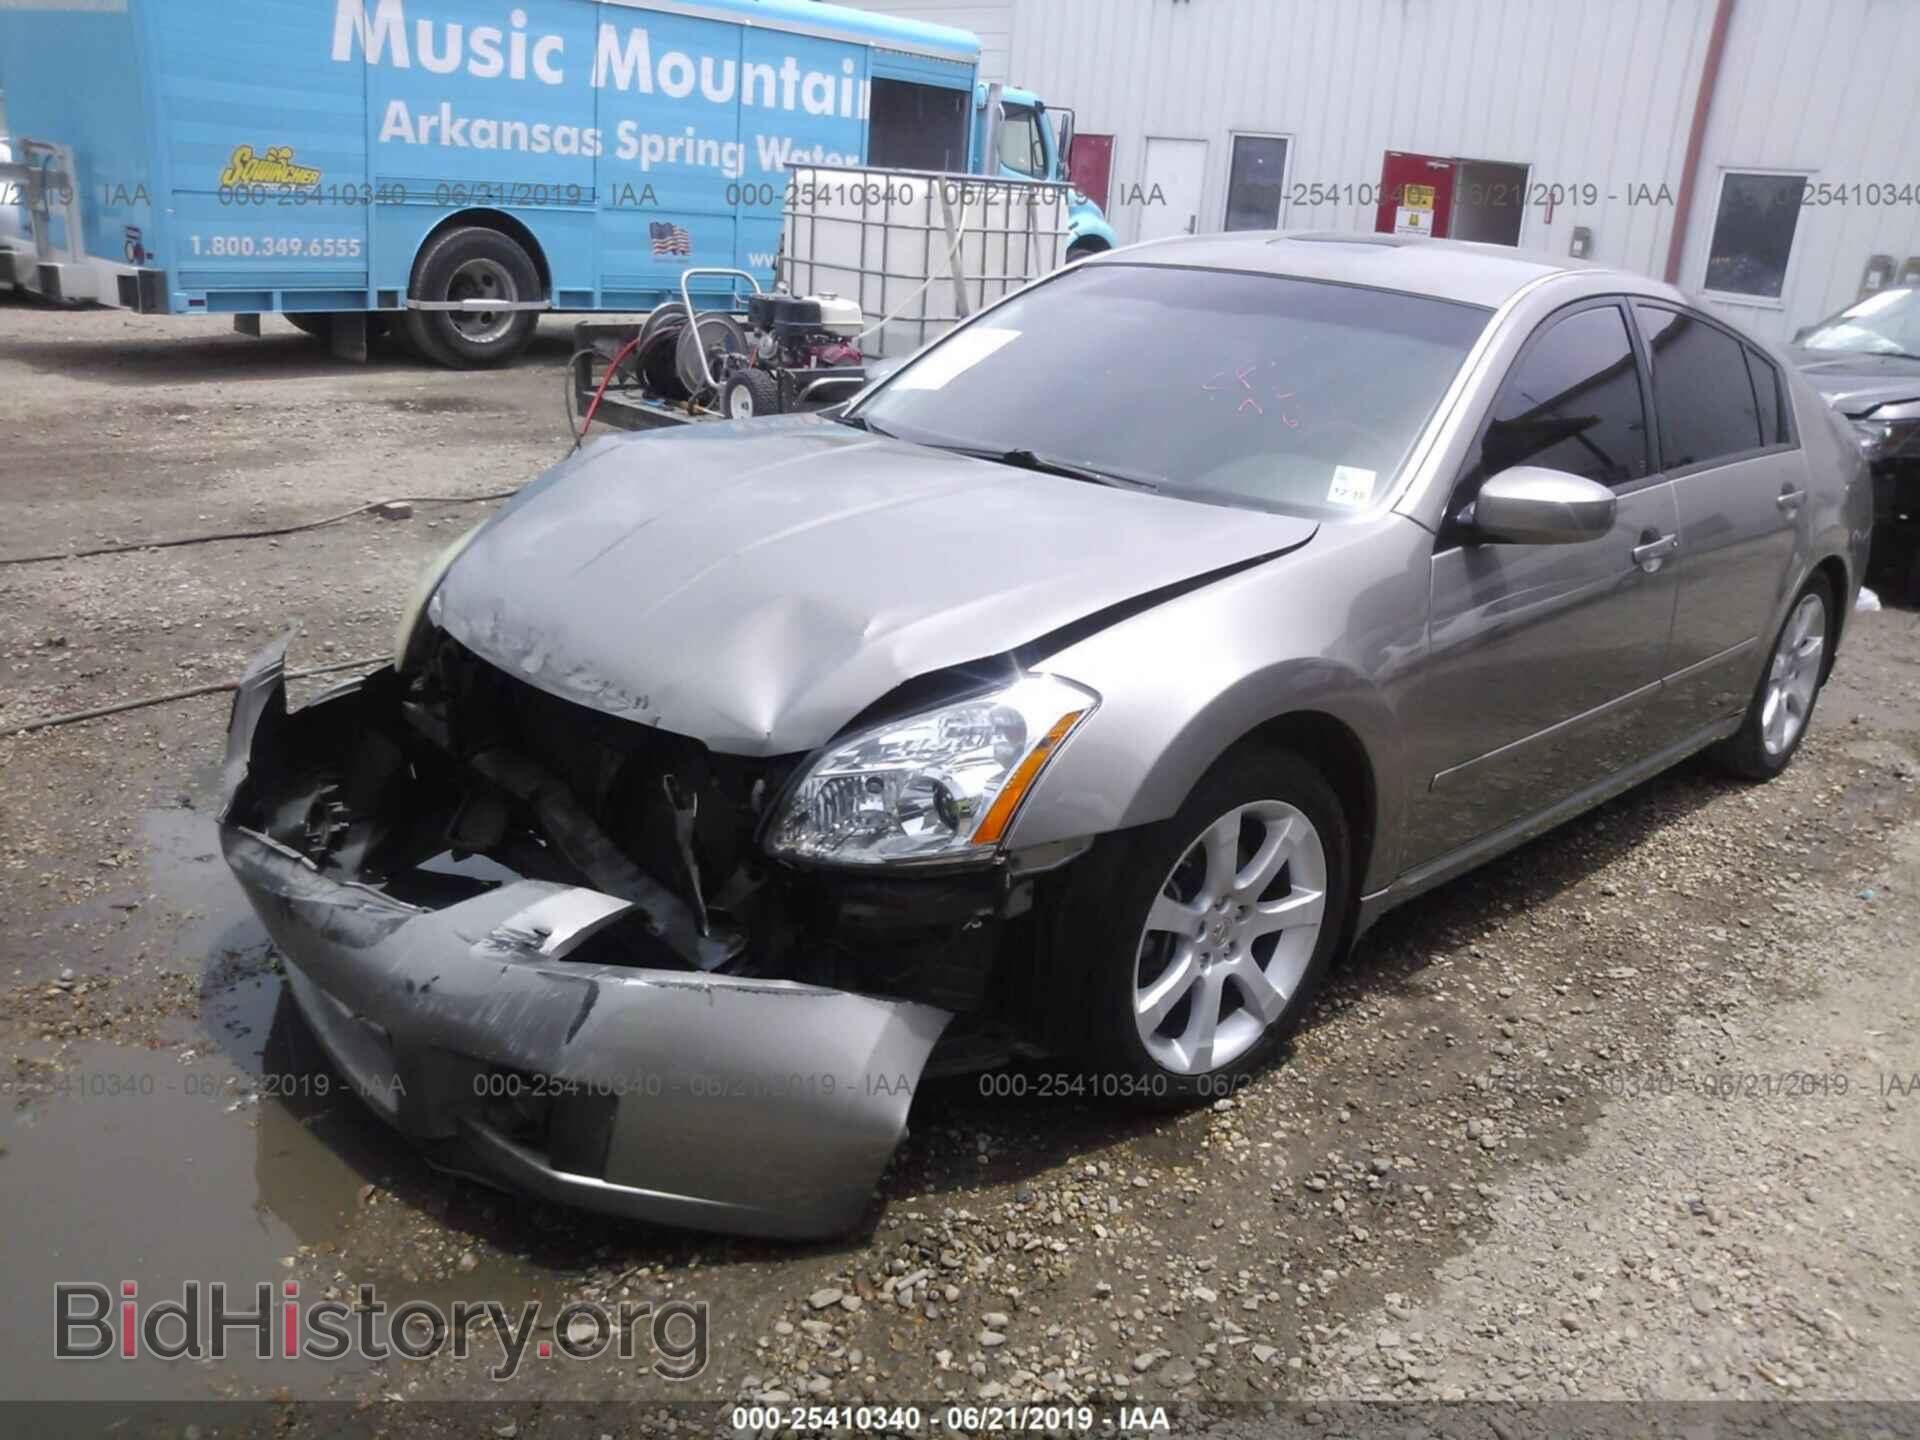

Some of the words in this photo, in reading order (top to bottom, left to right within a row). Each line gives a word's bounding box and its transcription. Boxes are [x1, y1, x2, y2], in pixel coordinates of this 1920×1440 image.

[331, 0, 564, 84] Music
[379, 99, 603, 157] Arkansas
[616, 120, 745, 178] Spring
[191, 235, 361, 257] 1.800.349.6555
